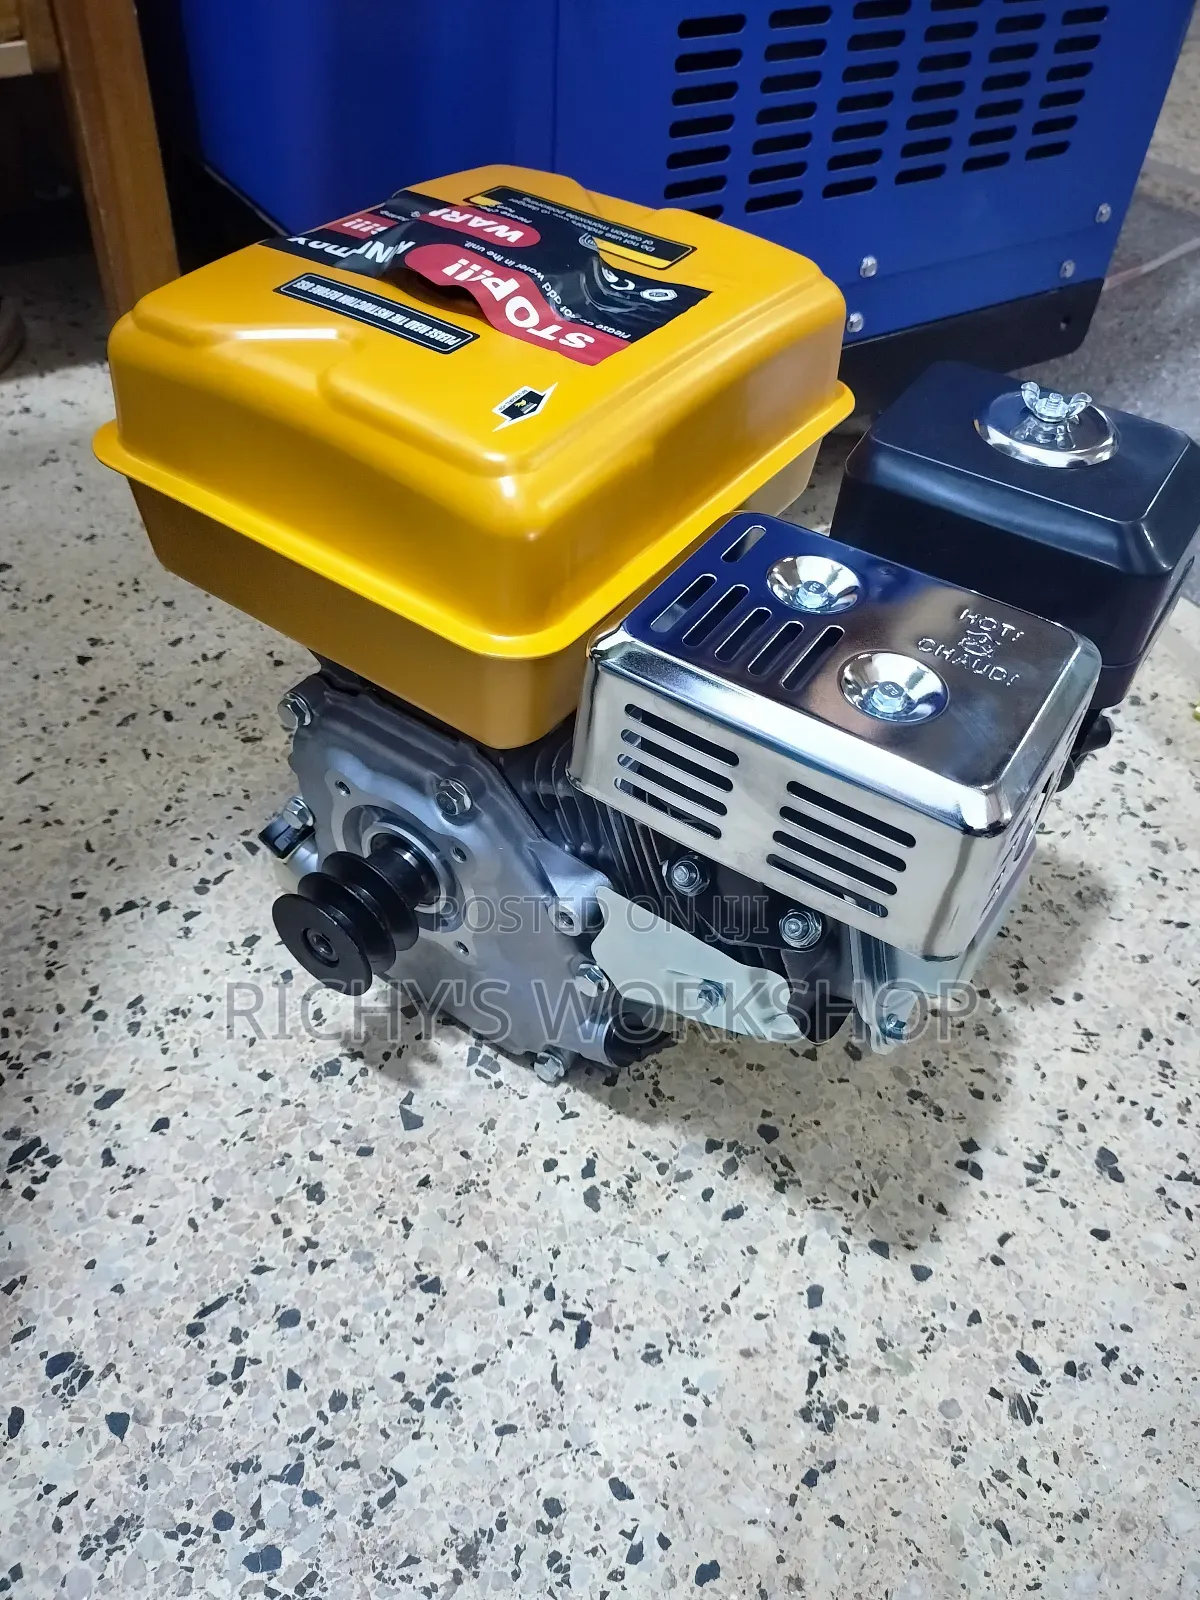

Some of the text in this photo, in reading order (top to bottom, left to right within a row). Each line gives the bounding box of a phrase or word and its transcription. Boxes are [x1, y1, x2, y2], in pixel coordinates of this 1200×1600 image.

[523, 197, 566, 215] poisoning
[566, 212, 609, 231] monoxide
[605, 232, 622, 241] use
[610, 227, 640, 242] carbon
[464, 240, 486, 253] unit.
[623, 239, 639, 248] not
[641, 245, 655, 253] Do
[487, 250, 505, 263] the
[504, 257, 515, 266] in
[515, 263, 545, 282] water
[542, 282, 562, 305] add
[292, 279, 461, 346] PLEASE READ THE INSTRUCTION BEFORE USE
[595, 324, 632, 339] Please
[959, 608, 1025, 642] HOT!
[917, 637, 1020, 687] CHAUD!
